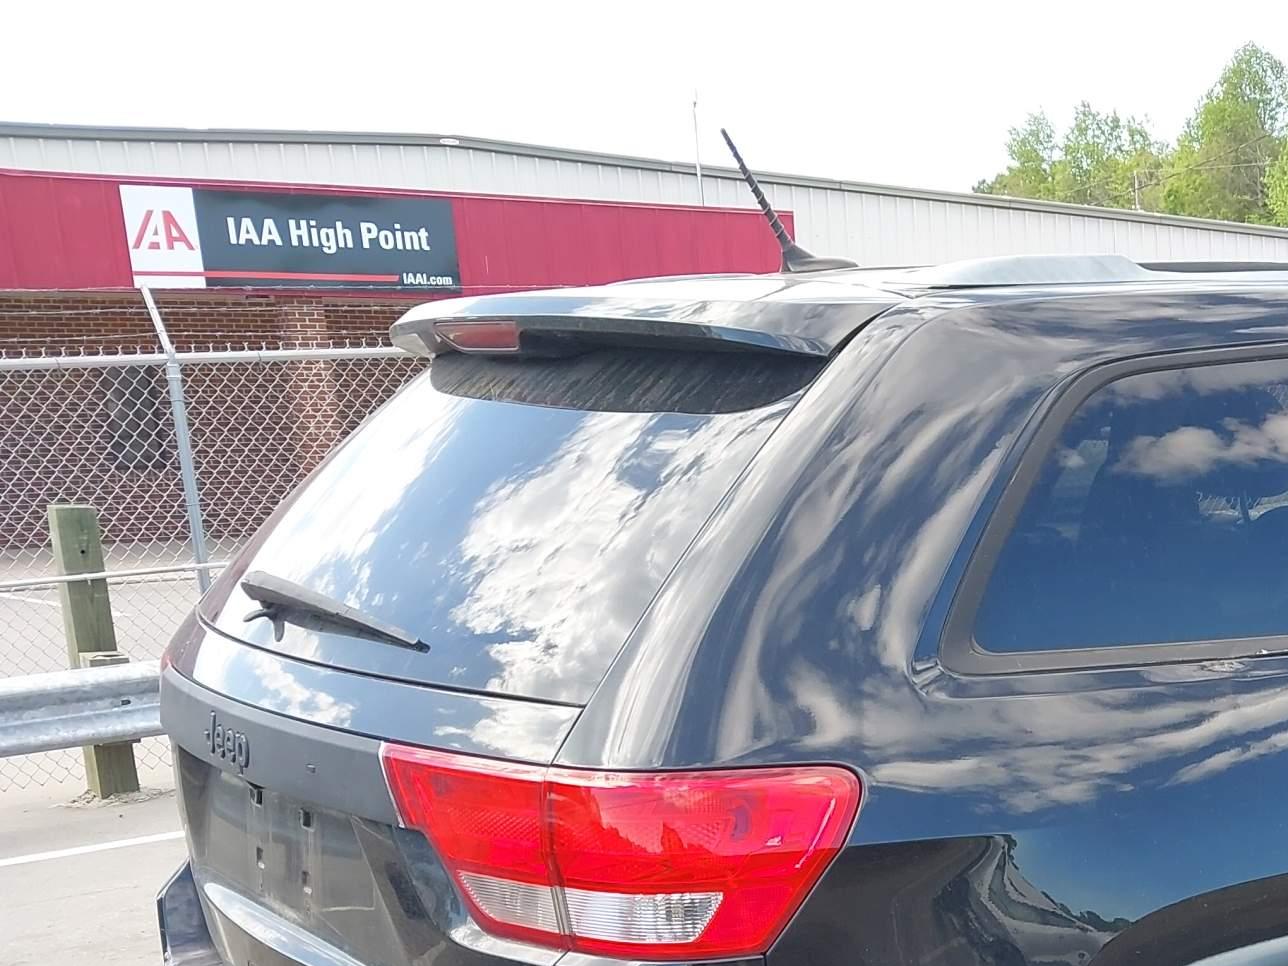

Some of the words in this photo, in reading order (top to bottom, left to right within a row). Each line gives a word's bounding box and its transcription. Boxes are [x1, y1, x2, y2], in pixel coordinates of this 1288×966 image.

[226, 216, 283, 246] IAA
[288, 219, 354, 254] High
[359, 222, 431, 251] Point
[402, 272, 453, 286] IAAI.com
[203, 710, 250, 777] Jeep
